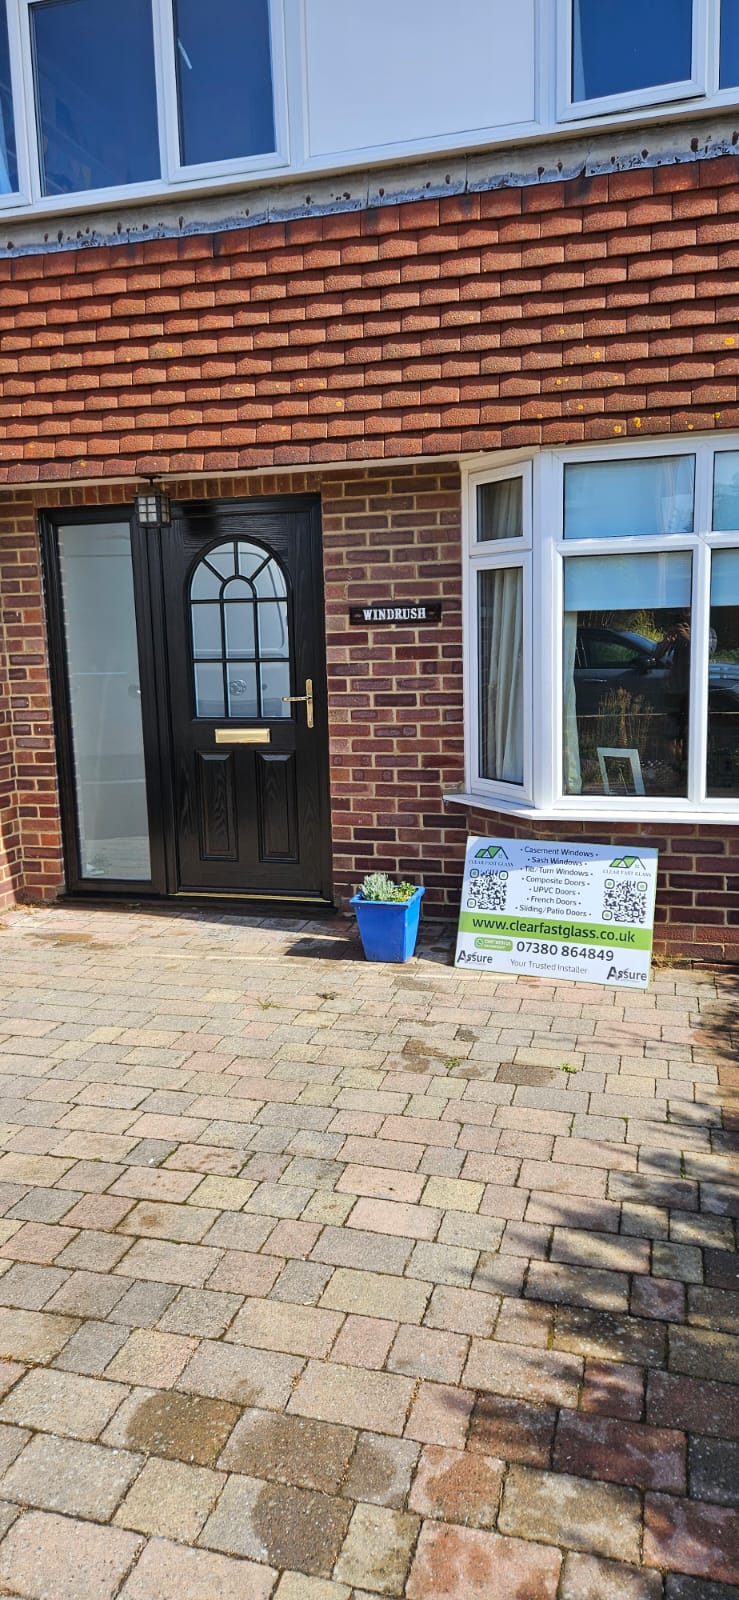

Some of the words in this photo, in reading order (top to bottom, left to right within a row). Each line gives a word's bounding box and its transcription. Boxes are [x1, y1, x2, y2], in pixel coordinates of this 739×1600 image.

[363, 607, 426, 620] WINDRUSH
[524, 846, 560, 855] Casement
[560, 848, 594, 858] Windows
[532, 856, 549, 864] Sash
[550, 857, 583, 867] Windows
[556, 867, 589, 877] Windows
[525, 875, 563, 885] Composite
[564, 878, 586, 887] Doors
[533, 886, 554, 894] UPVC
[555, 887, 576, 896] Doors
[530, 896, 554, 904] French
[556, 897, 577, 906] Doors
[520, 904, 565, 915] Sliding/Patio
[566, 909, 587, 917] Doors
[472, 918, 636, 943] www.clearfastglass.co.uk
[457, 949, 493, 964] Assure
[516, 941, 558, 956] 07380
[561, 945, 614, 962] 864849
[510, 958, 526, 967] Your
[528, 960, 556, 971] Trusted
[558, 963, 588, 974] Installer
[606, 966, 648, 981] Assure
